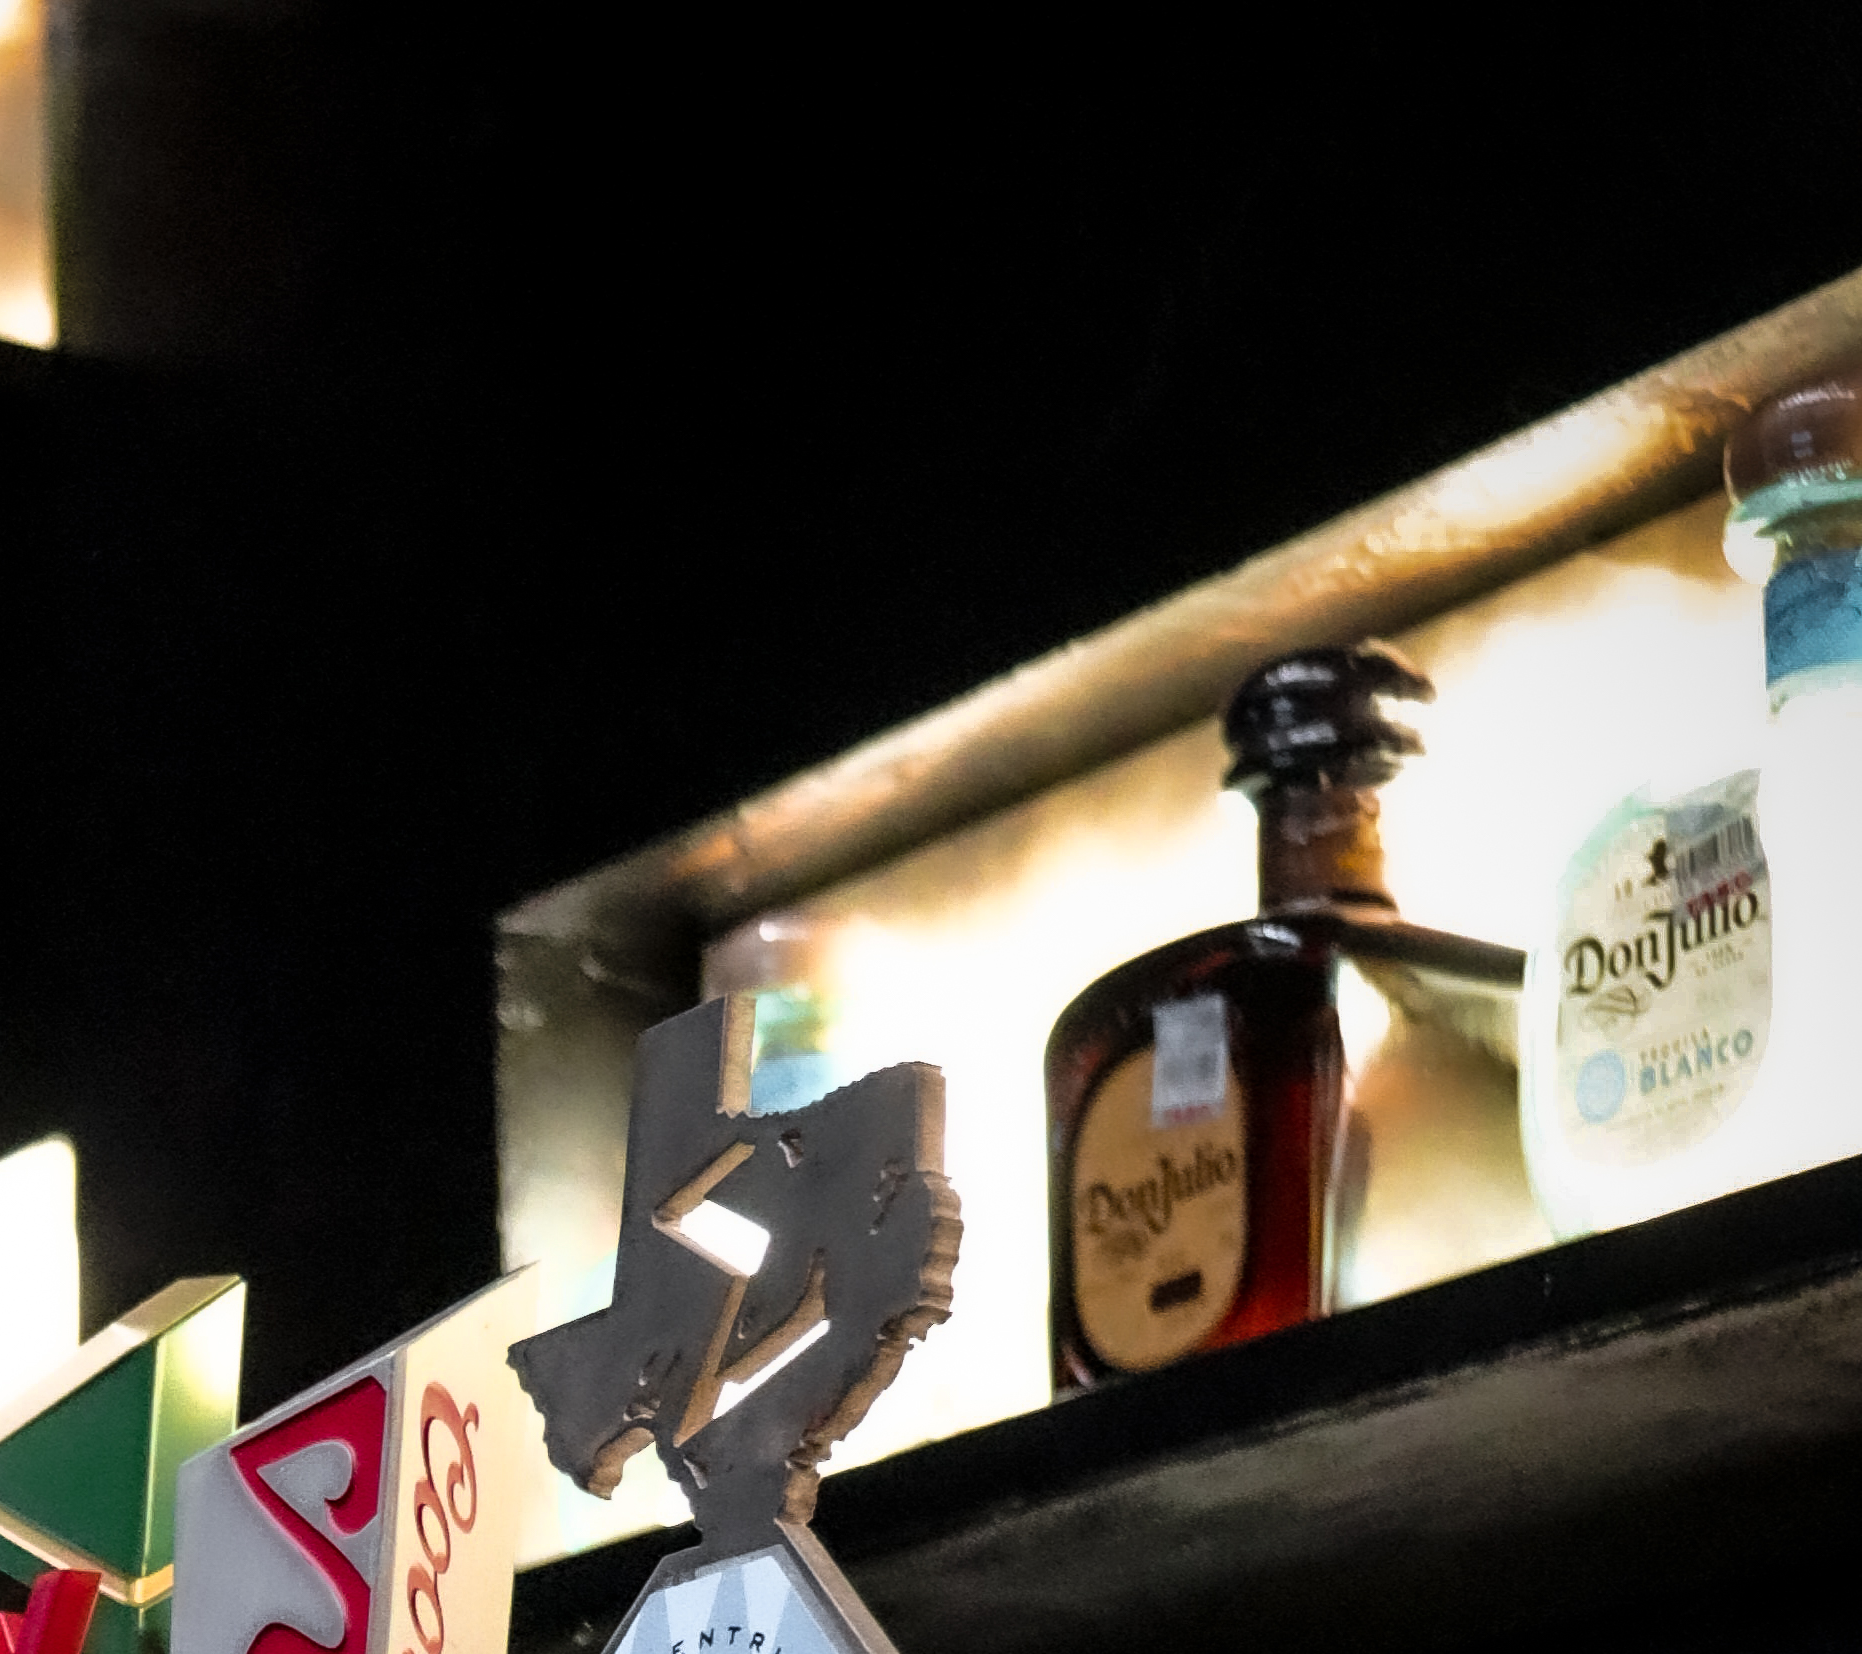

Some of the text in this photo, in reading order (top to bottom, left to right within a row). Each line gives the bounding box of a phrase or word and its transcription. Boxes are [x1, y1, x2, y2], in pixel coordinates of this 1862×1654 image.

[1563, 931, 1660, 998] Don
[1644, 885, 1759, 991] Julio
[1641, 1028, 1754, 1096] BLANCO
